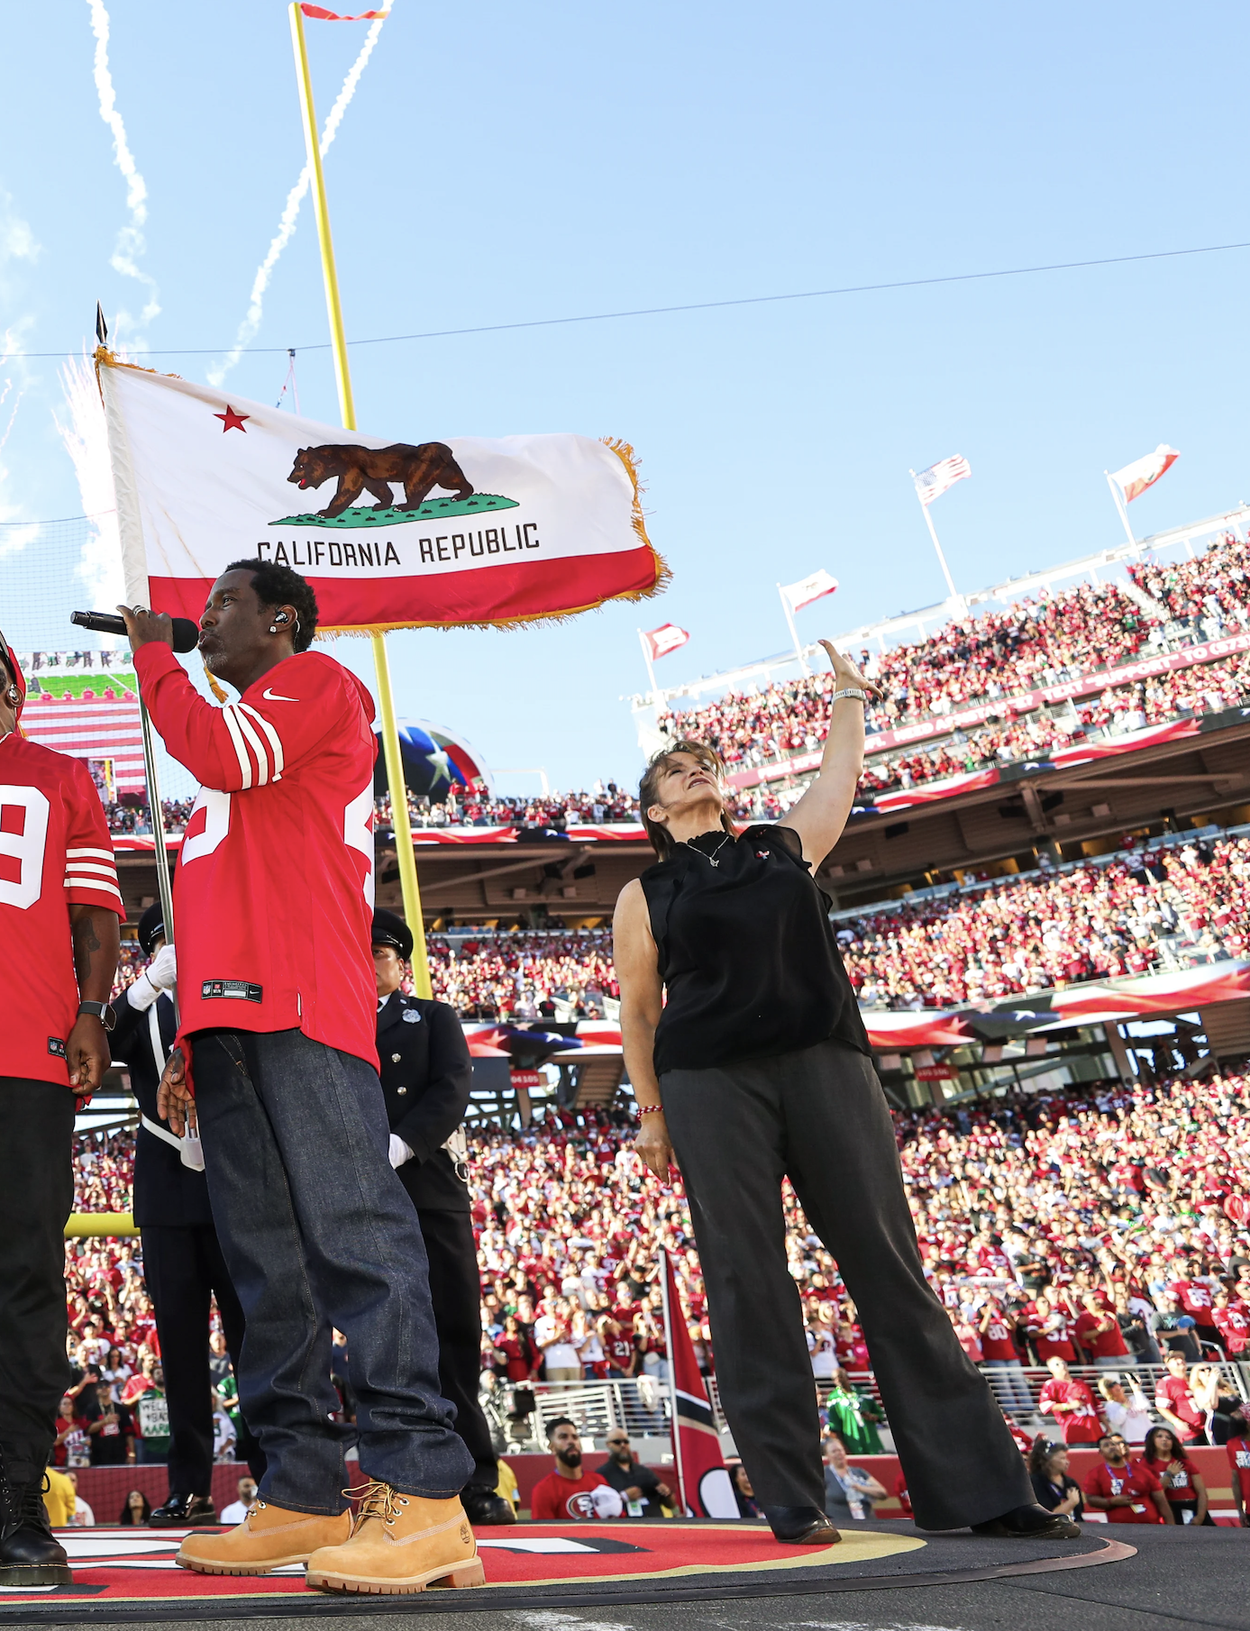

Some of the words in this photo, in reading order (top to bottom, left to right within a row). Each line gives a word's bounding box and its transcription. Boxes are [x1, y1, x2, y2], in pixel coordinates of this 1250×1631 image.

[257, 541, 401, 567] CALIFORNIA
[418, 523, 540, 563] REPUBLIC
[893, 722, 935, 742] NEED
[1041, 680, 1085, 700] TEXT
[1085, 654, 1180, 687] "SUPPORT"
[1180, 646, 1208, 662] TO
[613, 1341, 630, 1356] 21
